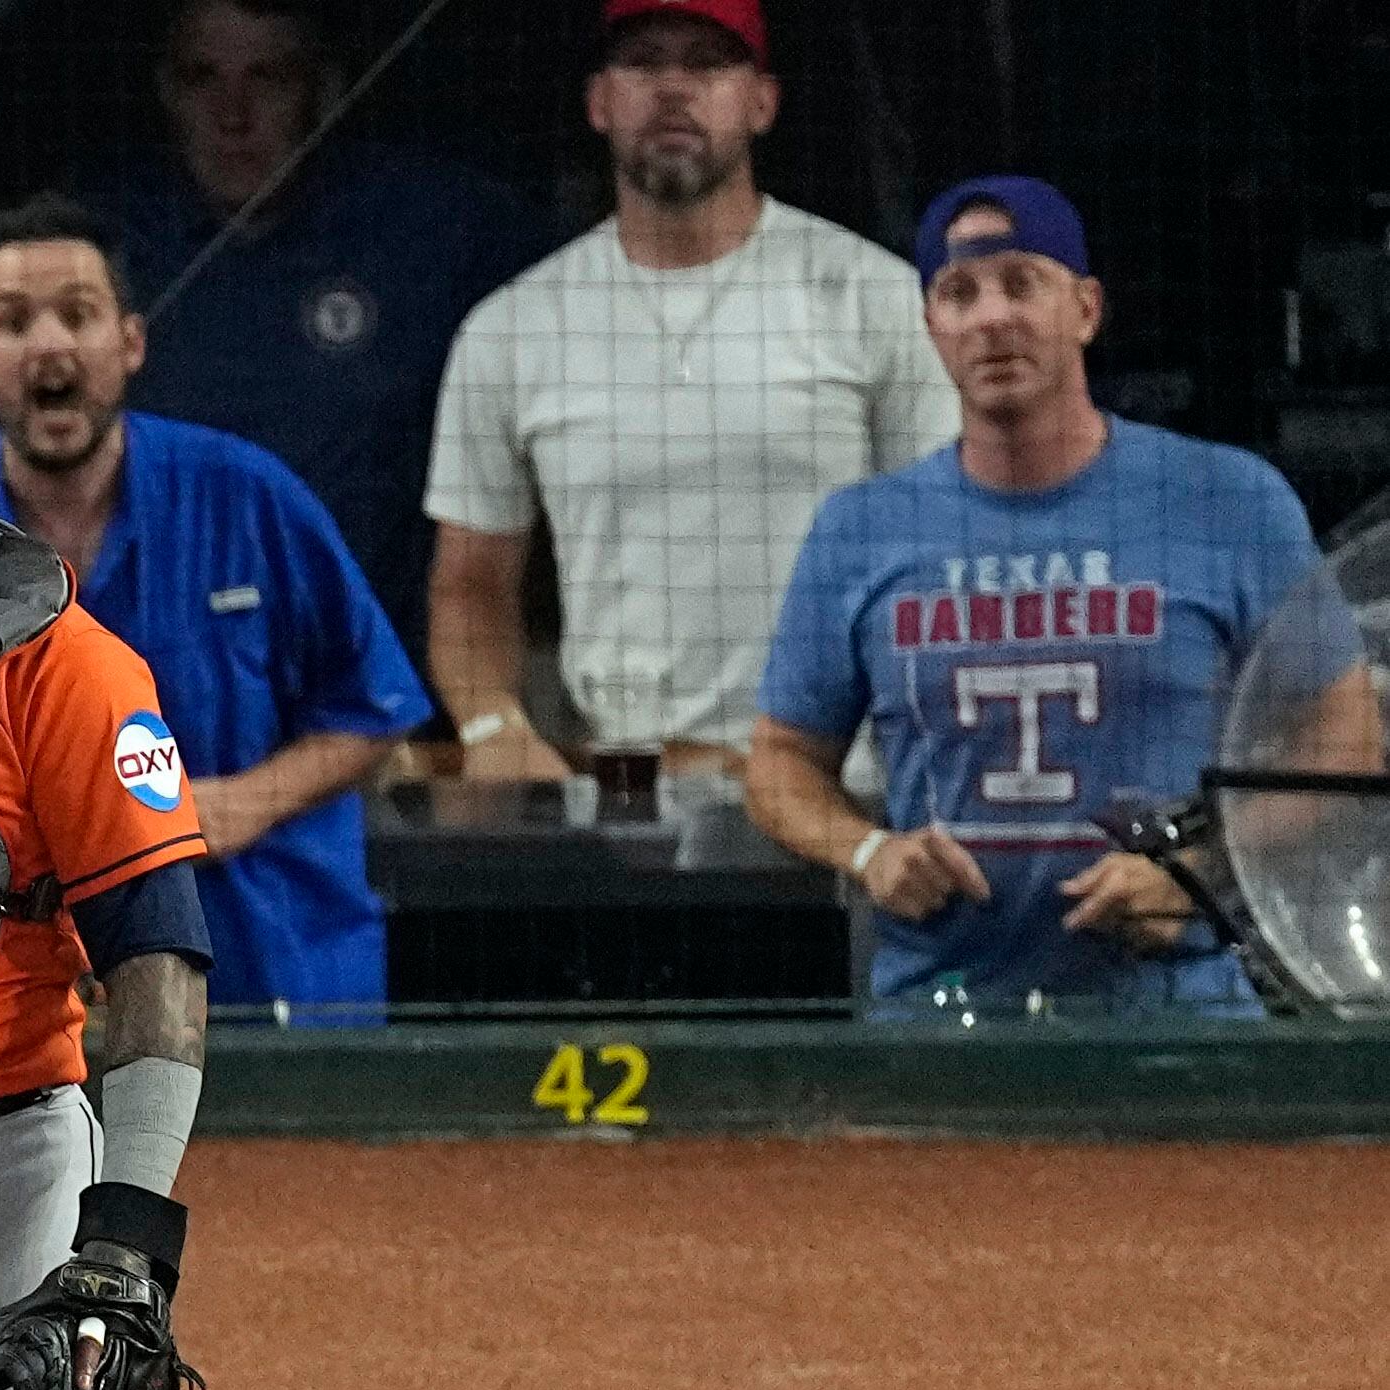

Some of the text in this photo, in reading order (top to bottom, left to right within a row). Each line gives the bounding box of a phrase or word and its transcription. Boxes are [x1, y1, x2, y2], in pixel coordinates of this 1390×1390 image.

[117, 745, 175, 779] OXY
[954, 661, 1100, 805] T
[533, 1042, 650, 1125] 42
